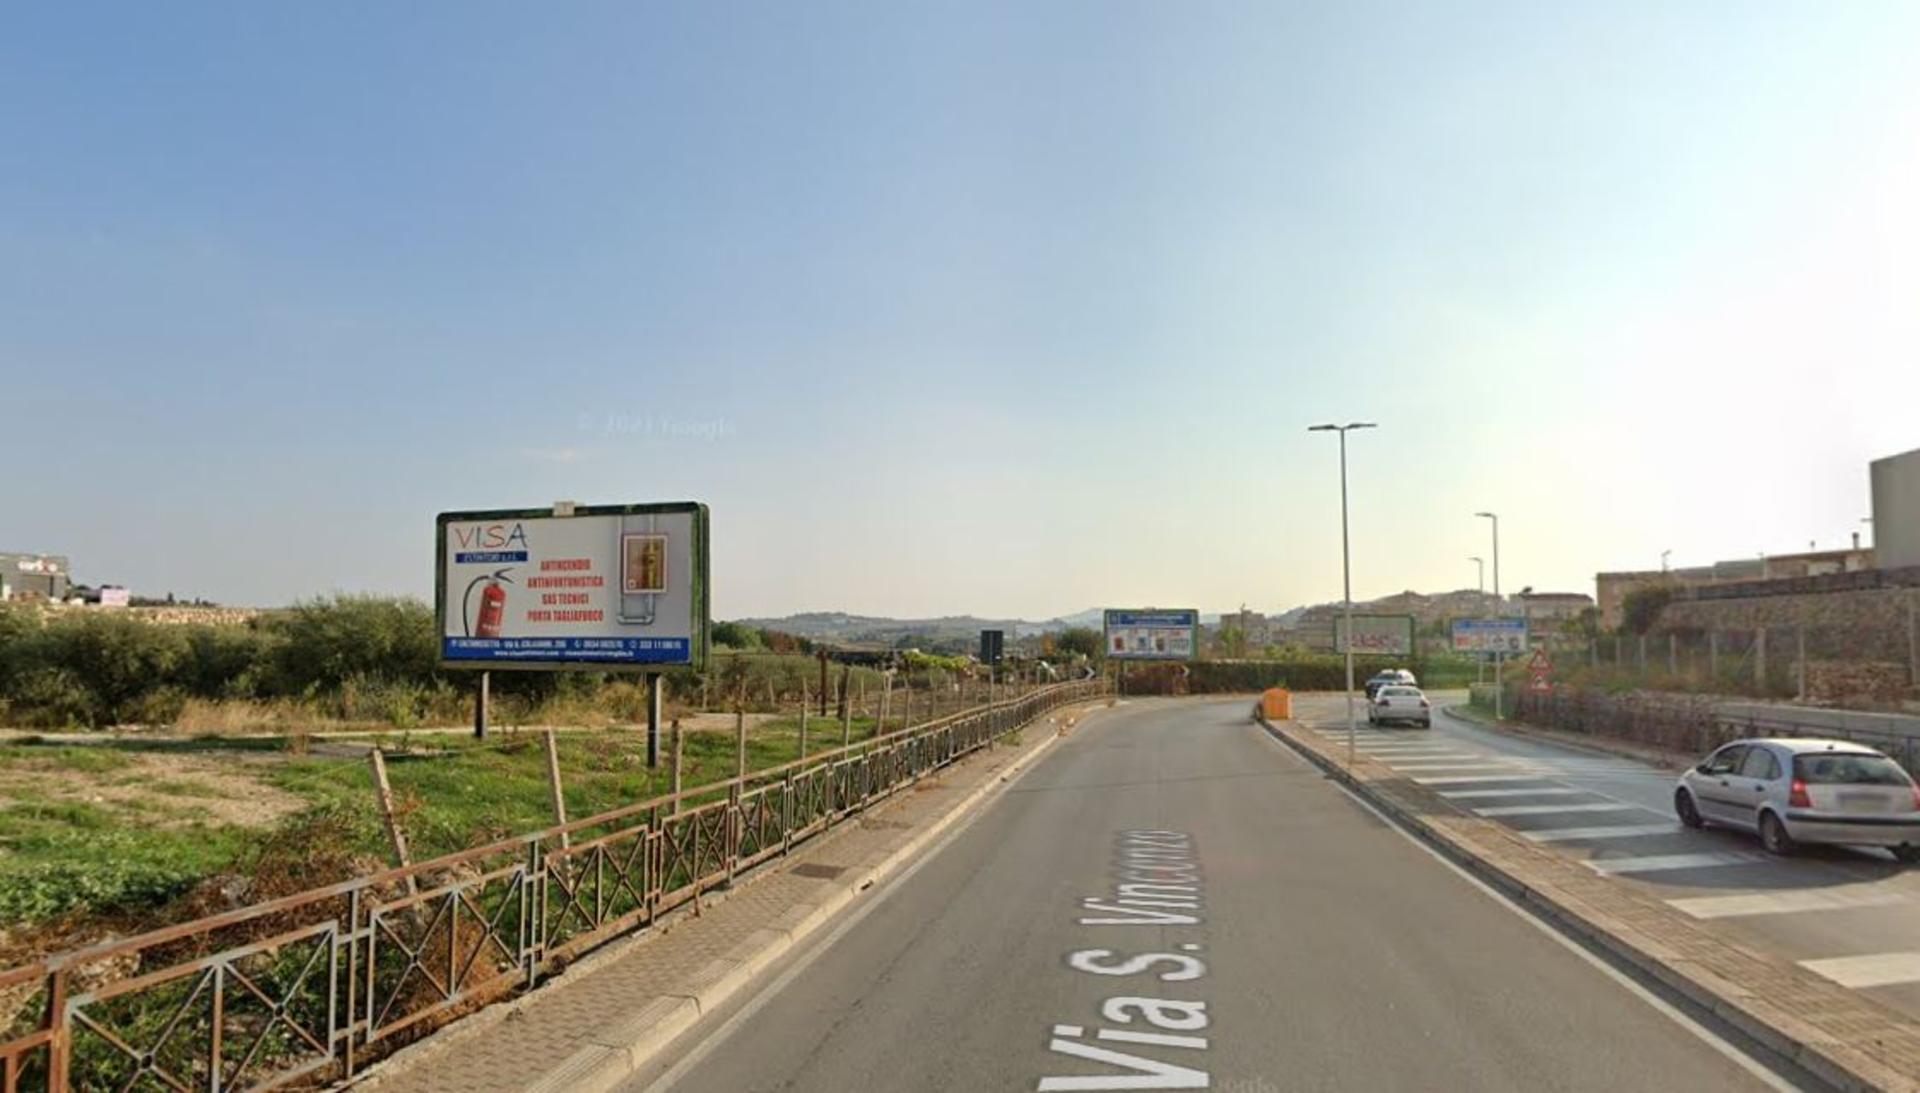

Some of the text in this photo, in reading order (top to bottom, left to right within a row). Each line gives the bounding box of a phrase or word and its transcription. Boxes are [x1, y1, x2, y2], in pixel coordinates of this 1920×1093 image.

[454, 523, 527, 548] VISA
[540, 559, 590, 571] ANTINCENDIO
[527, 575, 603, 588] ANTINFORTUNISTICA
[542, 592, 589, 605] GAS TECNICI
[527, 609, 603, 622] PORTA TAGLIAFUOCO
